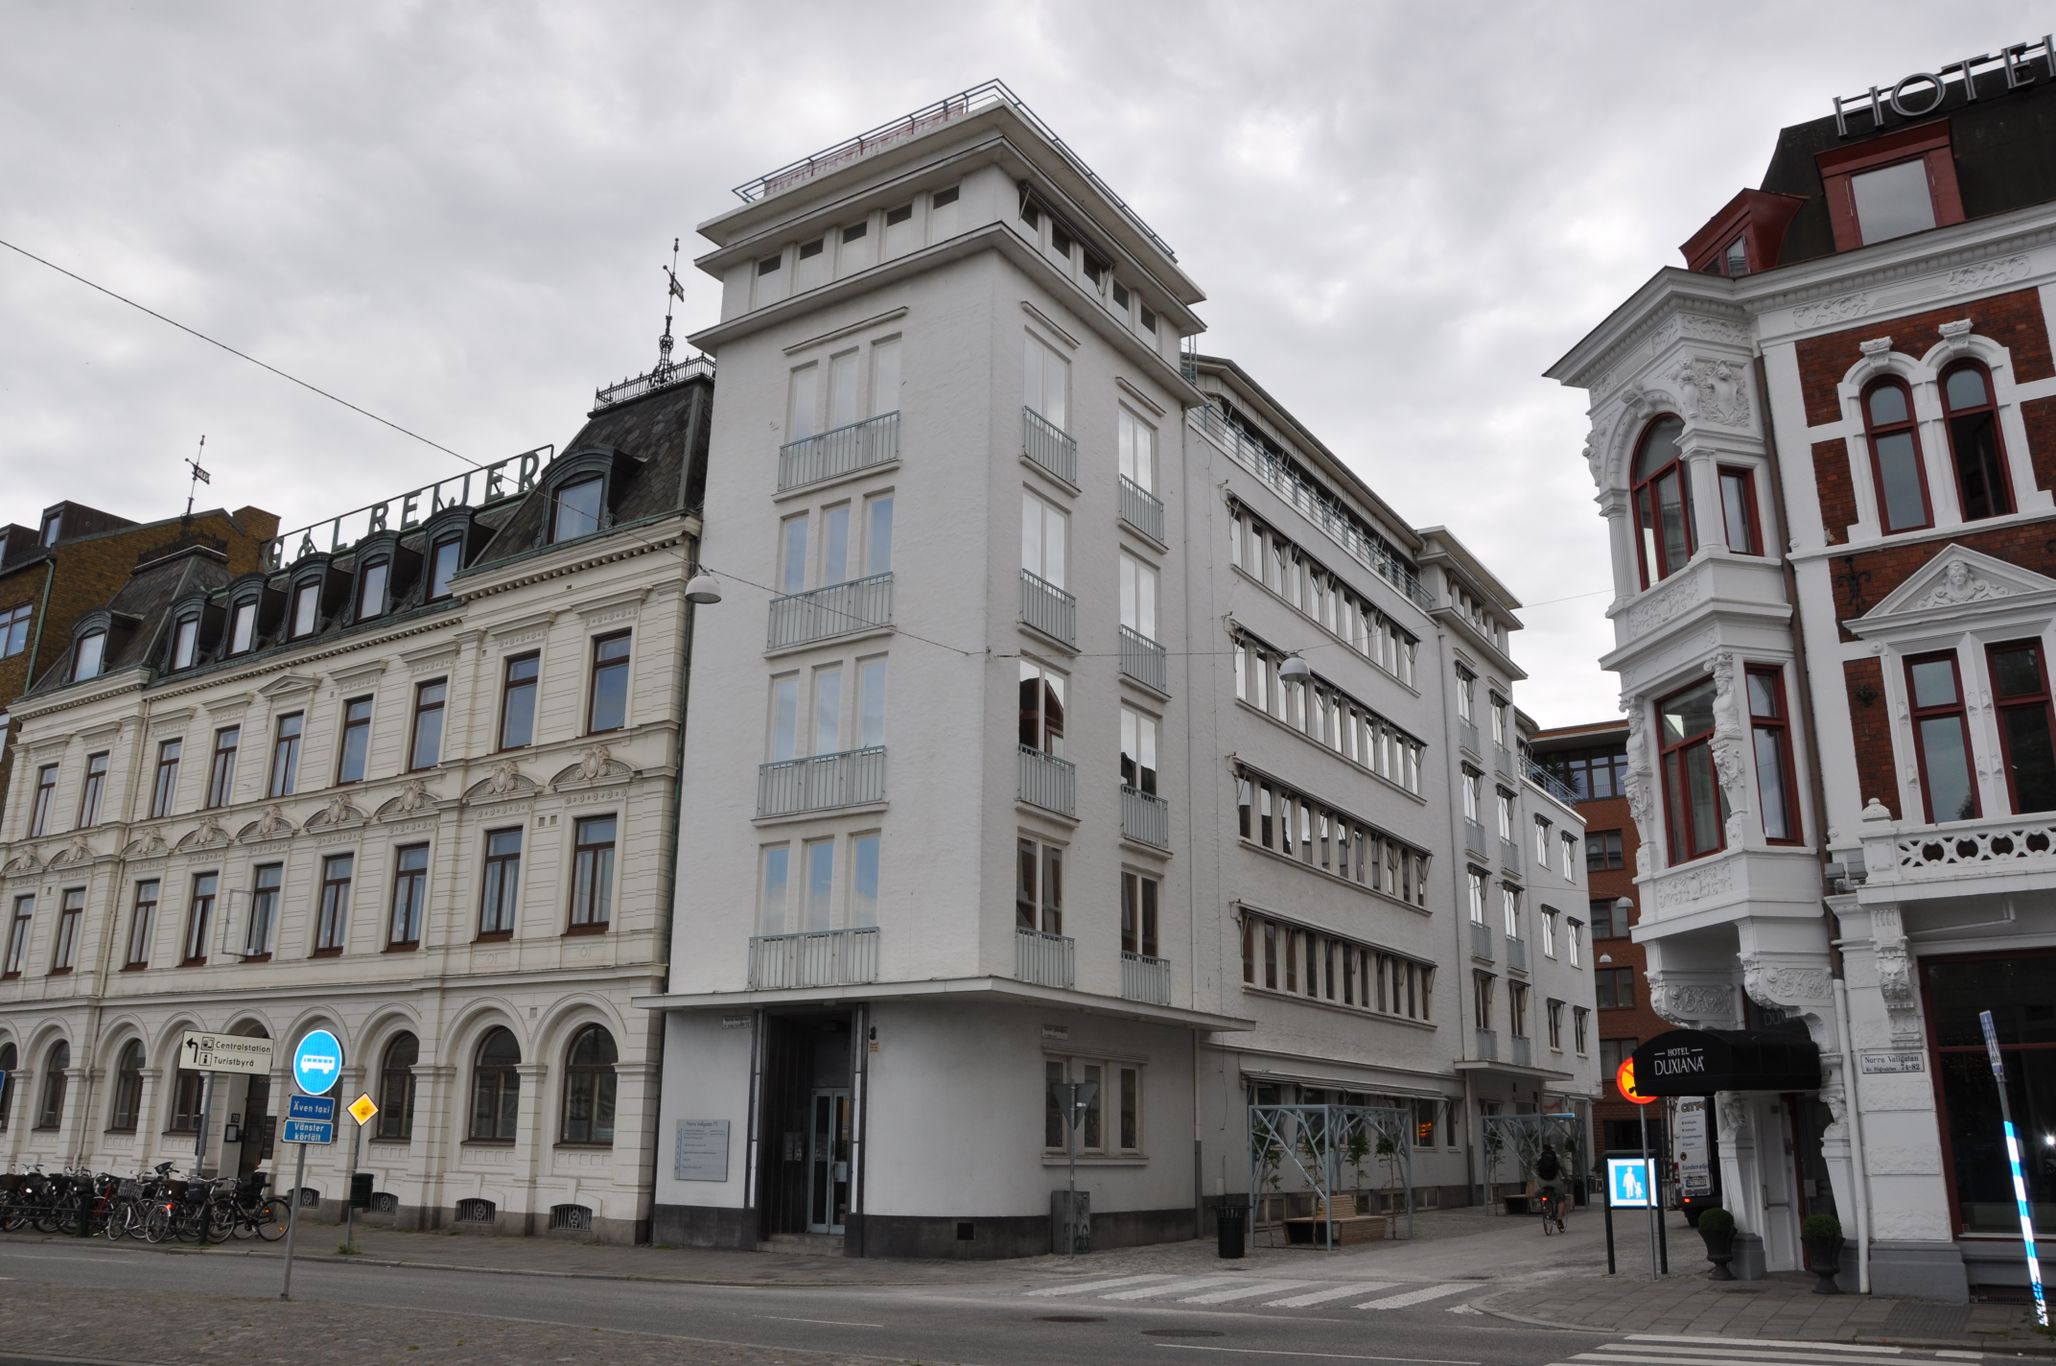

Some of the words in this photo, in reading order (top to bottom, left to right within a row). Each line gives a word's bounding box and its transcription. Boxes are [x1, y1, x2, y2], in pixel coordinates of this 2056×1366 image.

[368, 451, 540, 534] BEIJER
[215, 1041, 271, 1053] Centralstation
[1667, 1047, 1690, 1057] HOTEL
[214, 1056, 255, 1068] Turistbyrå
[1654, 1056, 1705, 1076] DUXIANA
[293, 1101, 314, 1113] Även
[315, 1105, 331, 1114] taxi
[294, 1122, 324, 1132] Vänster
[294, 1132, 321, 1142] körfält
